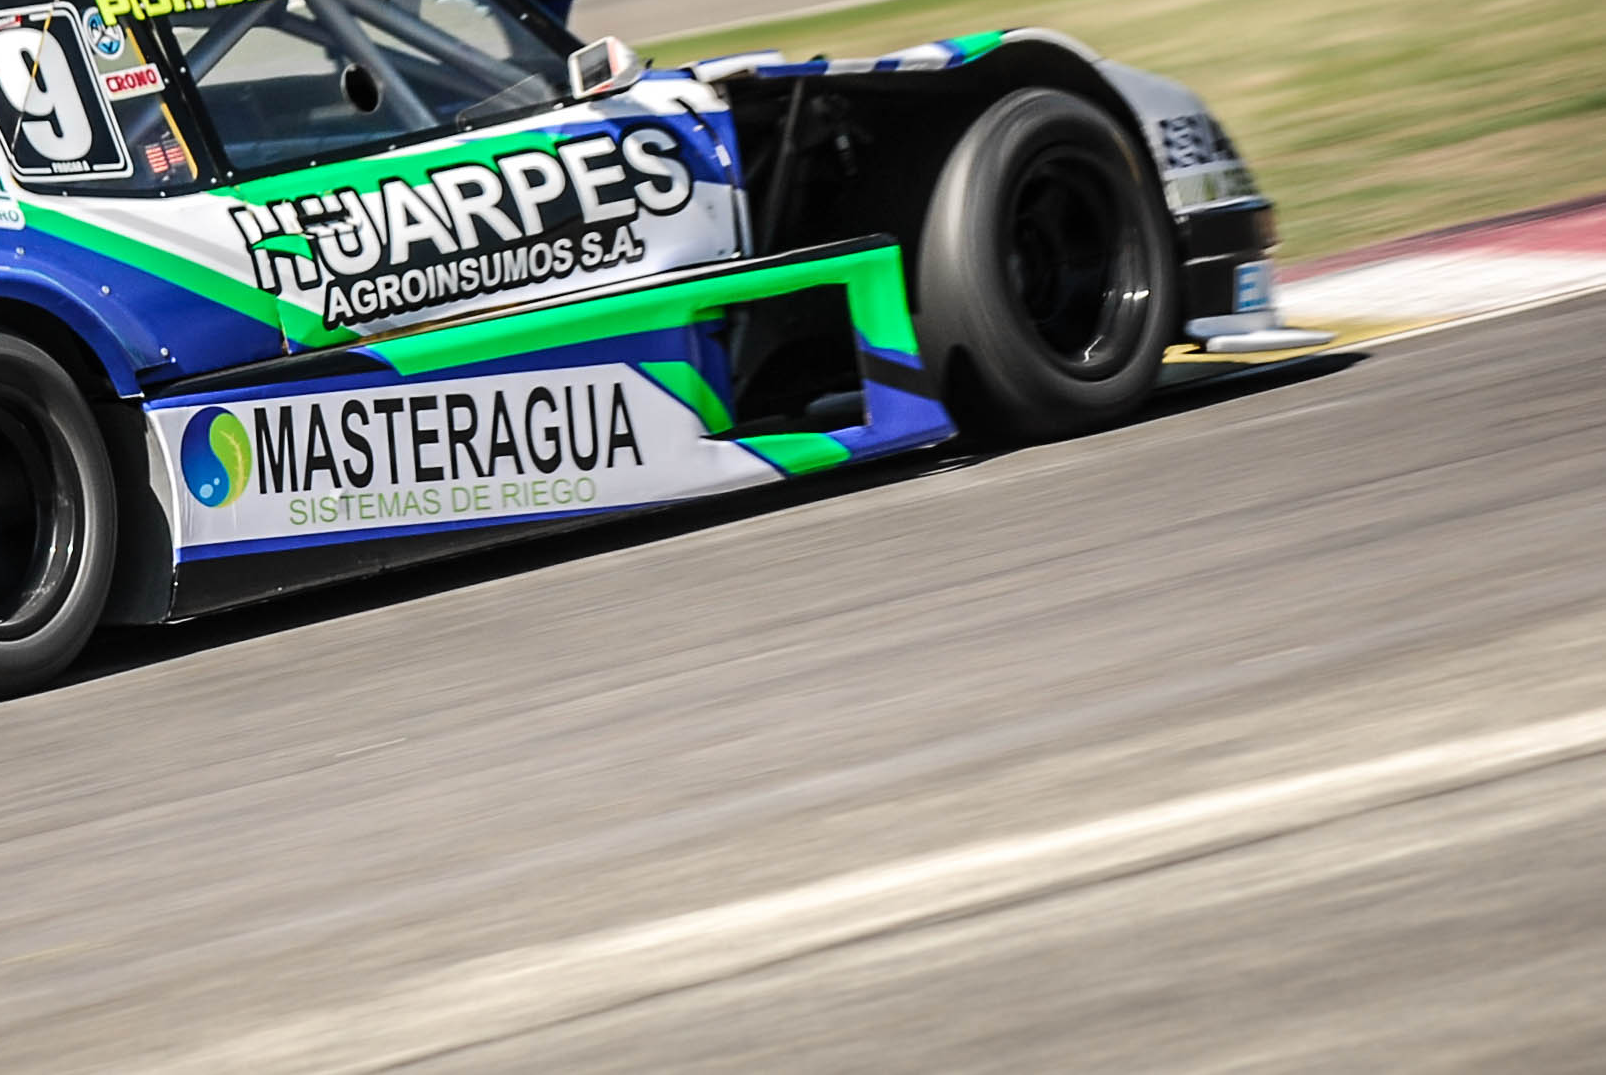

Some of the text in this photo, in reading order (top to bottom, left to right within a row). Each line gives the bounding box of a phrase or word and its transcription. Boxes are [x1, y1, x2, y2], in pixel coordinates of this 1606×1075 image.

[326, 228, 644, 323] AGROINSUMOS S.A.
[253, 382, 644, 495] MASTERAGUA
[289, 477, 596, 526] SISTEMAS DE RIEGO
